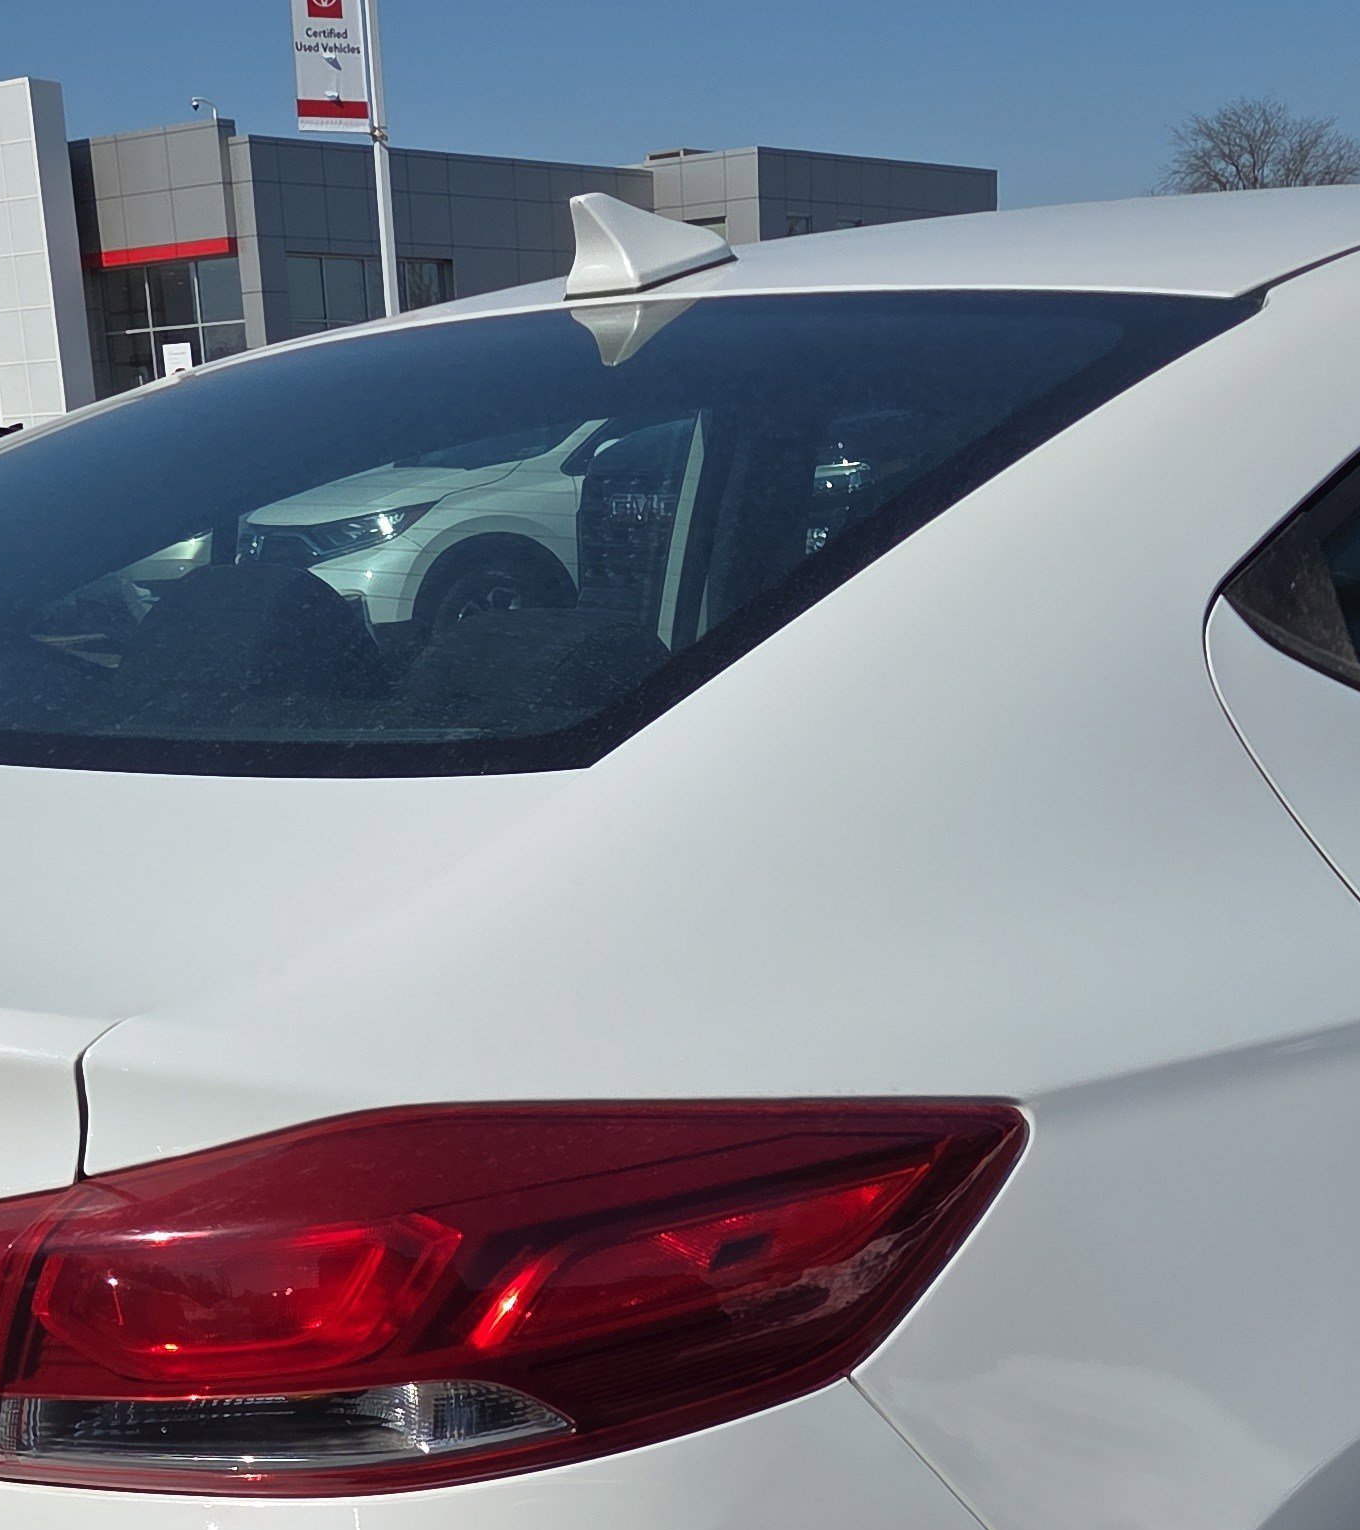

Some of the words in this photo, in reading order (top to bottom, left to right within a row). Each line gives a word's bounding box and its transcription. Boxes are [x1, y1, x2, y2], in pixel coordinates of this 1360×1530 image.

[305, 27, 348, 39] Certified
[295, 41, 320, 53] Used
[321, 43, 361, 55] Vehicles
